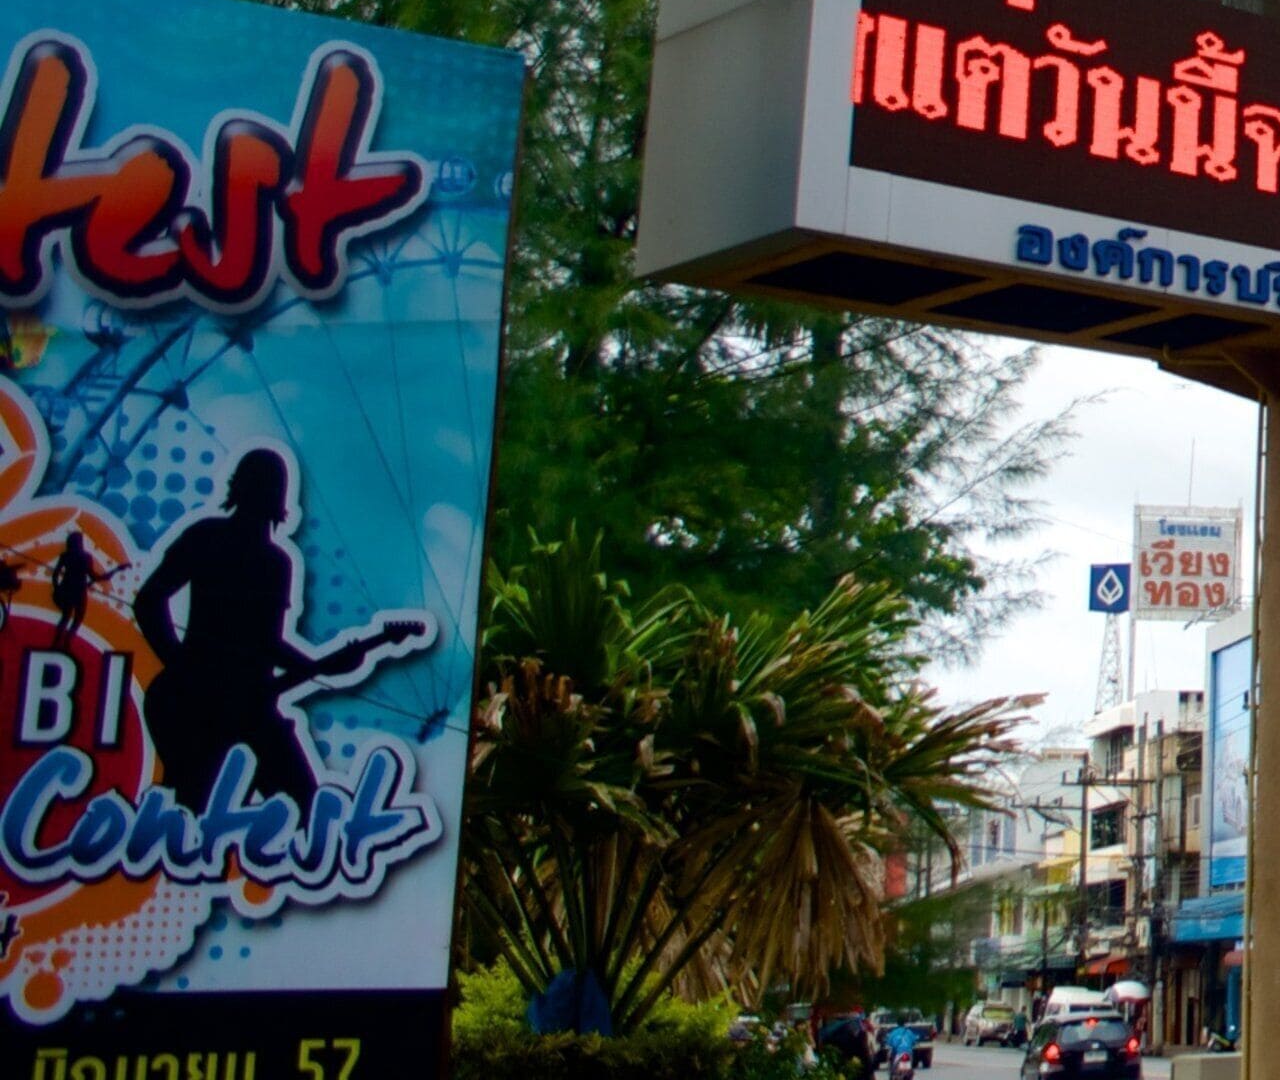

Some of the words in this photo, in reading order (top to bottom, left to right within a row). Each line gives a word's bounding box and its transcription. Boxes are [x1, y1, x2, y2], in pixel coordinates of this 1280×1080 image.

[1140, 538, 1229, 577] เวียง
[1143, 580, 1226, 608] ทอง
[2, 745, 406, 876] Contest
[33, 1048, 257, 1080] มิถนายน
[299, 1038, 361, 1080] 57
